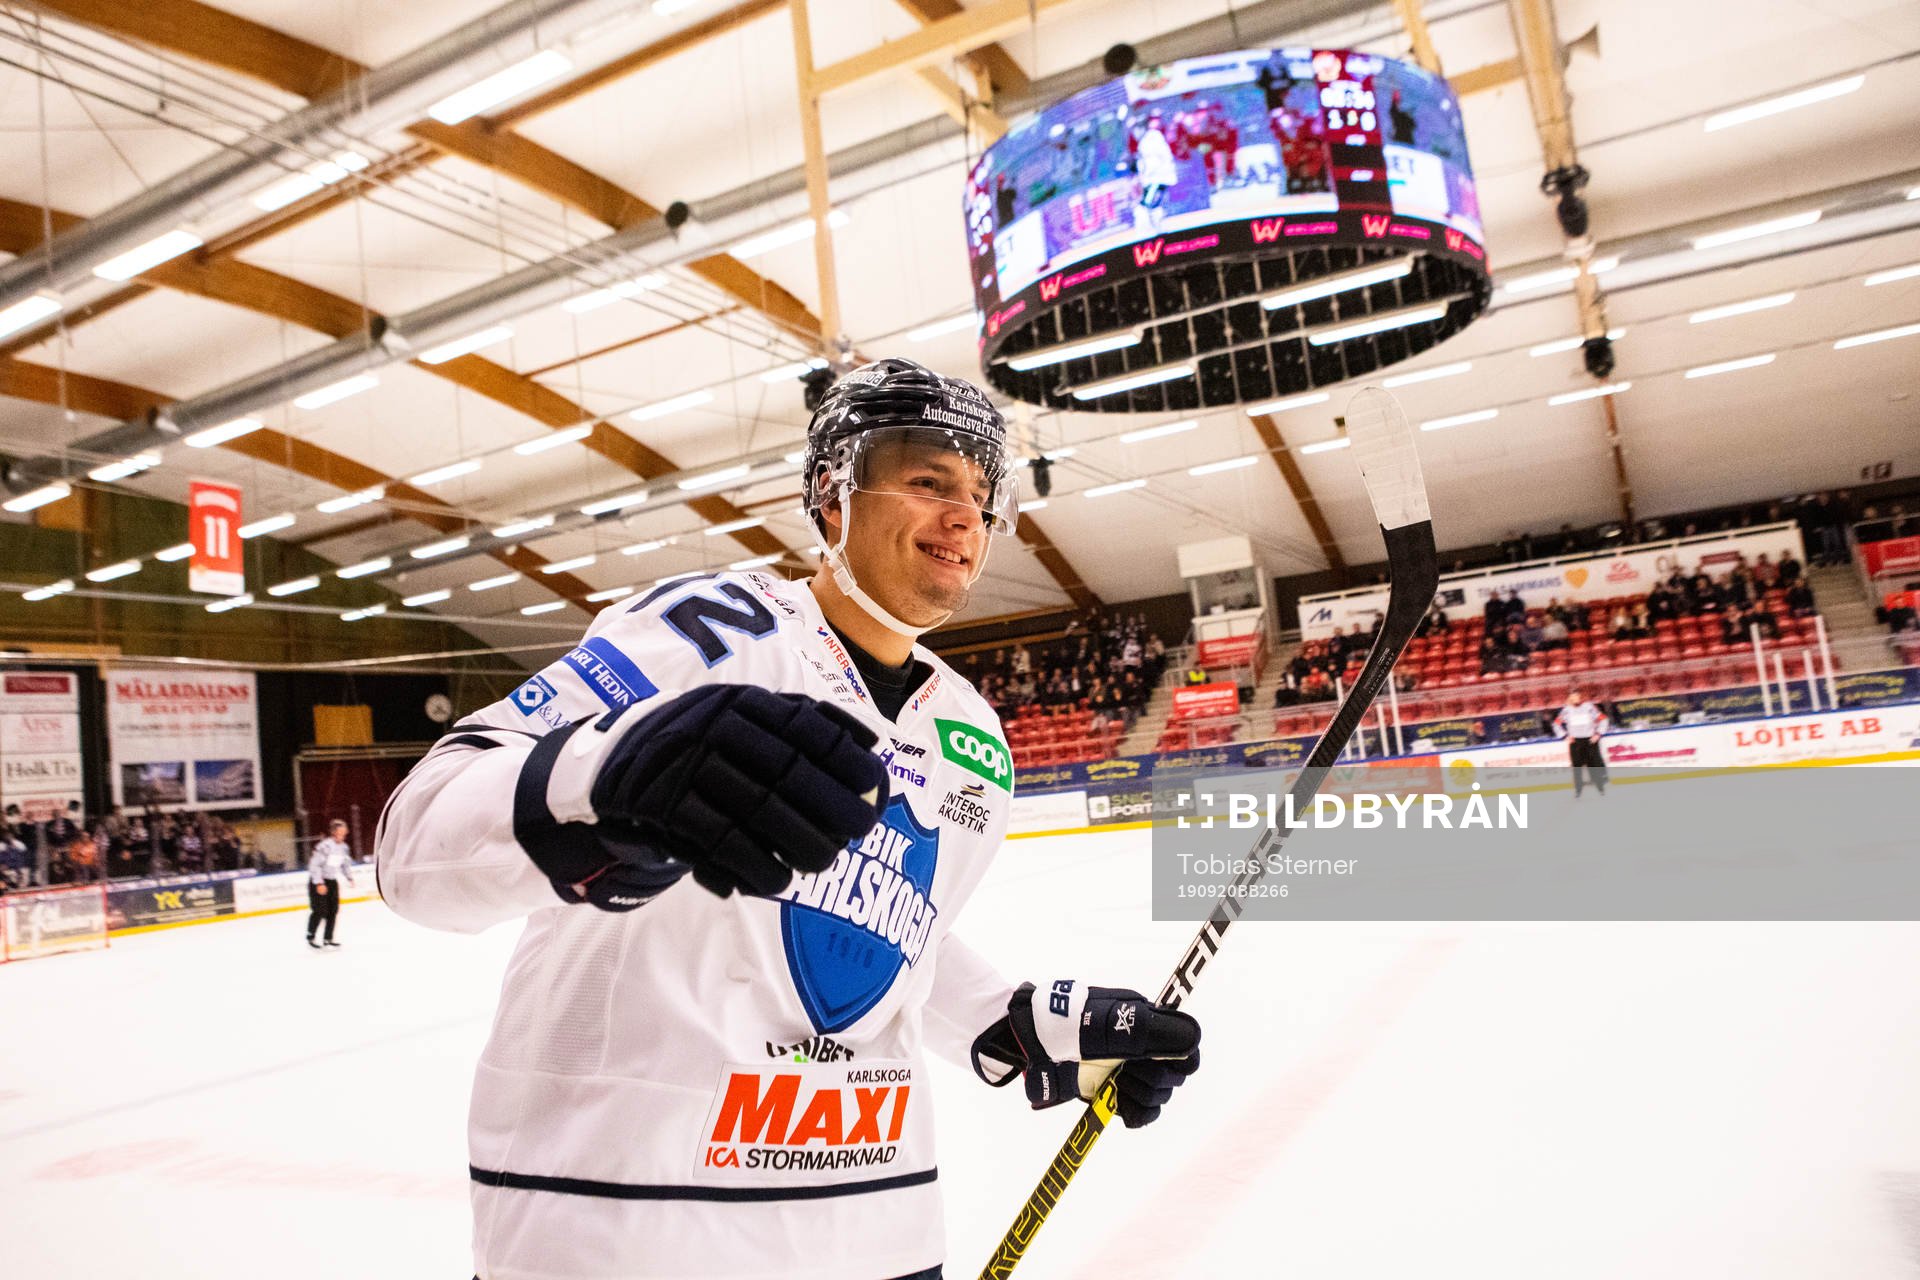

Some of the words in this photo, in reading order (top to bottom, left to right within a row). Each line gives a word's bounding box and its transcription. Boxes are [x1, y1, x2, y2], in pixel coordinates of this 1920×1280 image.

[949, 396, 993, 423] Karlskoga
[204, 515, 229, 559] 11
[569, 648, 593, 669] ARL
[824, 636, 867, 699] INTERSPORT
[919, 674, 941, 704] INTER
[1840, 718, 1883, 737] AB
[890, 737, 926, 759] AUER
[949, 730, 1008, 780] coop
[938, 804, 986, 834] AKUSTIK
[943, 792, 990, 822] INTEROC
[858, 822, 913, 875] BIK
[774, 849, 937, 969] ARLSKOGA
[847, 1068, 912, 1084] KARLSKOGA
[711, 1072, 911, 1146] MAXI
[704, 1146, 740, 1169] ICA
[745, 1146, 897, 1171] STORMARKNAD
